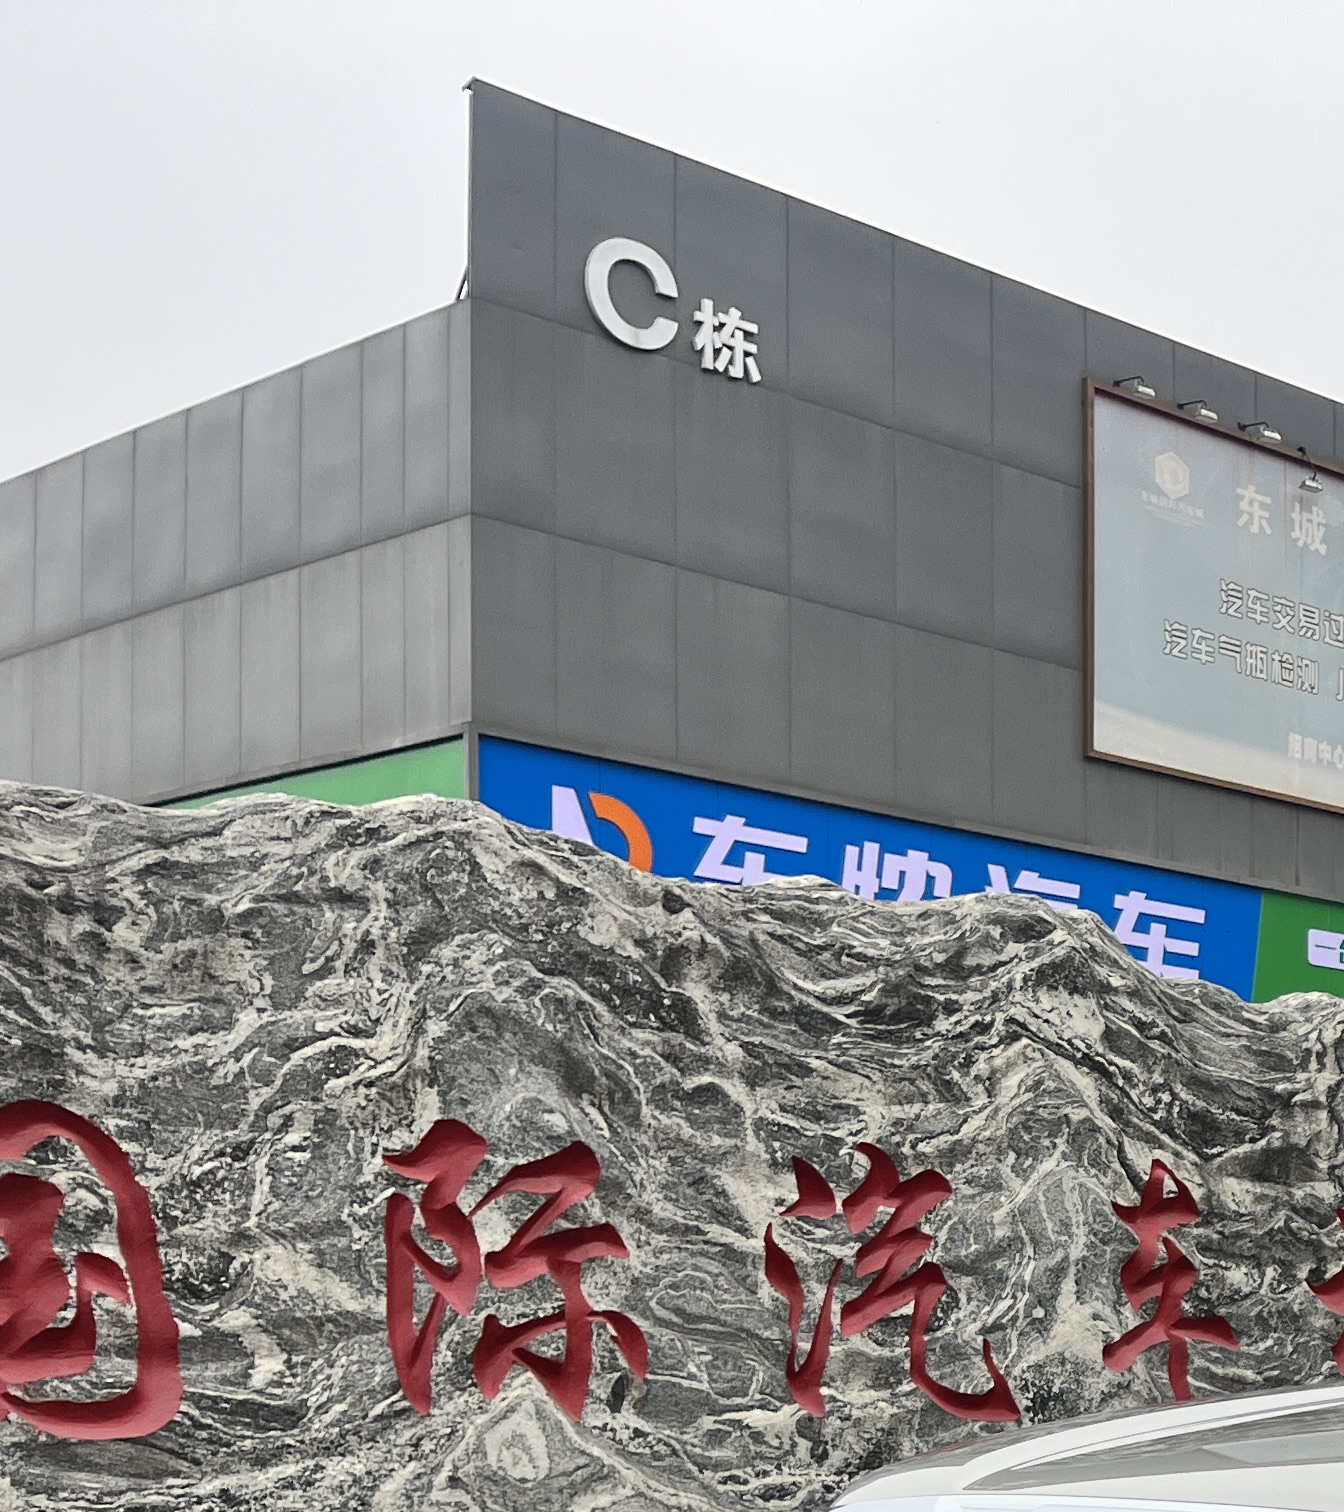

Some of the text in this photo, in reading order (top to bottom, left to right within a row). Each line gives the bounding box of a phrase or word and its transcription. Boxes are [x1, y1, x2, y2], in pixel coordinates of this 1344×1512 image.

[583, 236, 763, 385] C栋
[1162, 618, 1320, 695] 汽车气瓶检测
